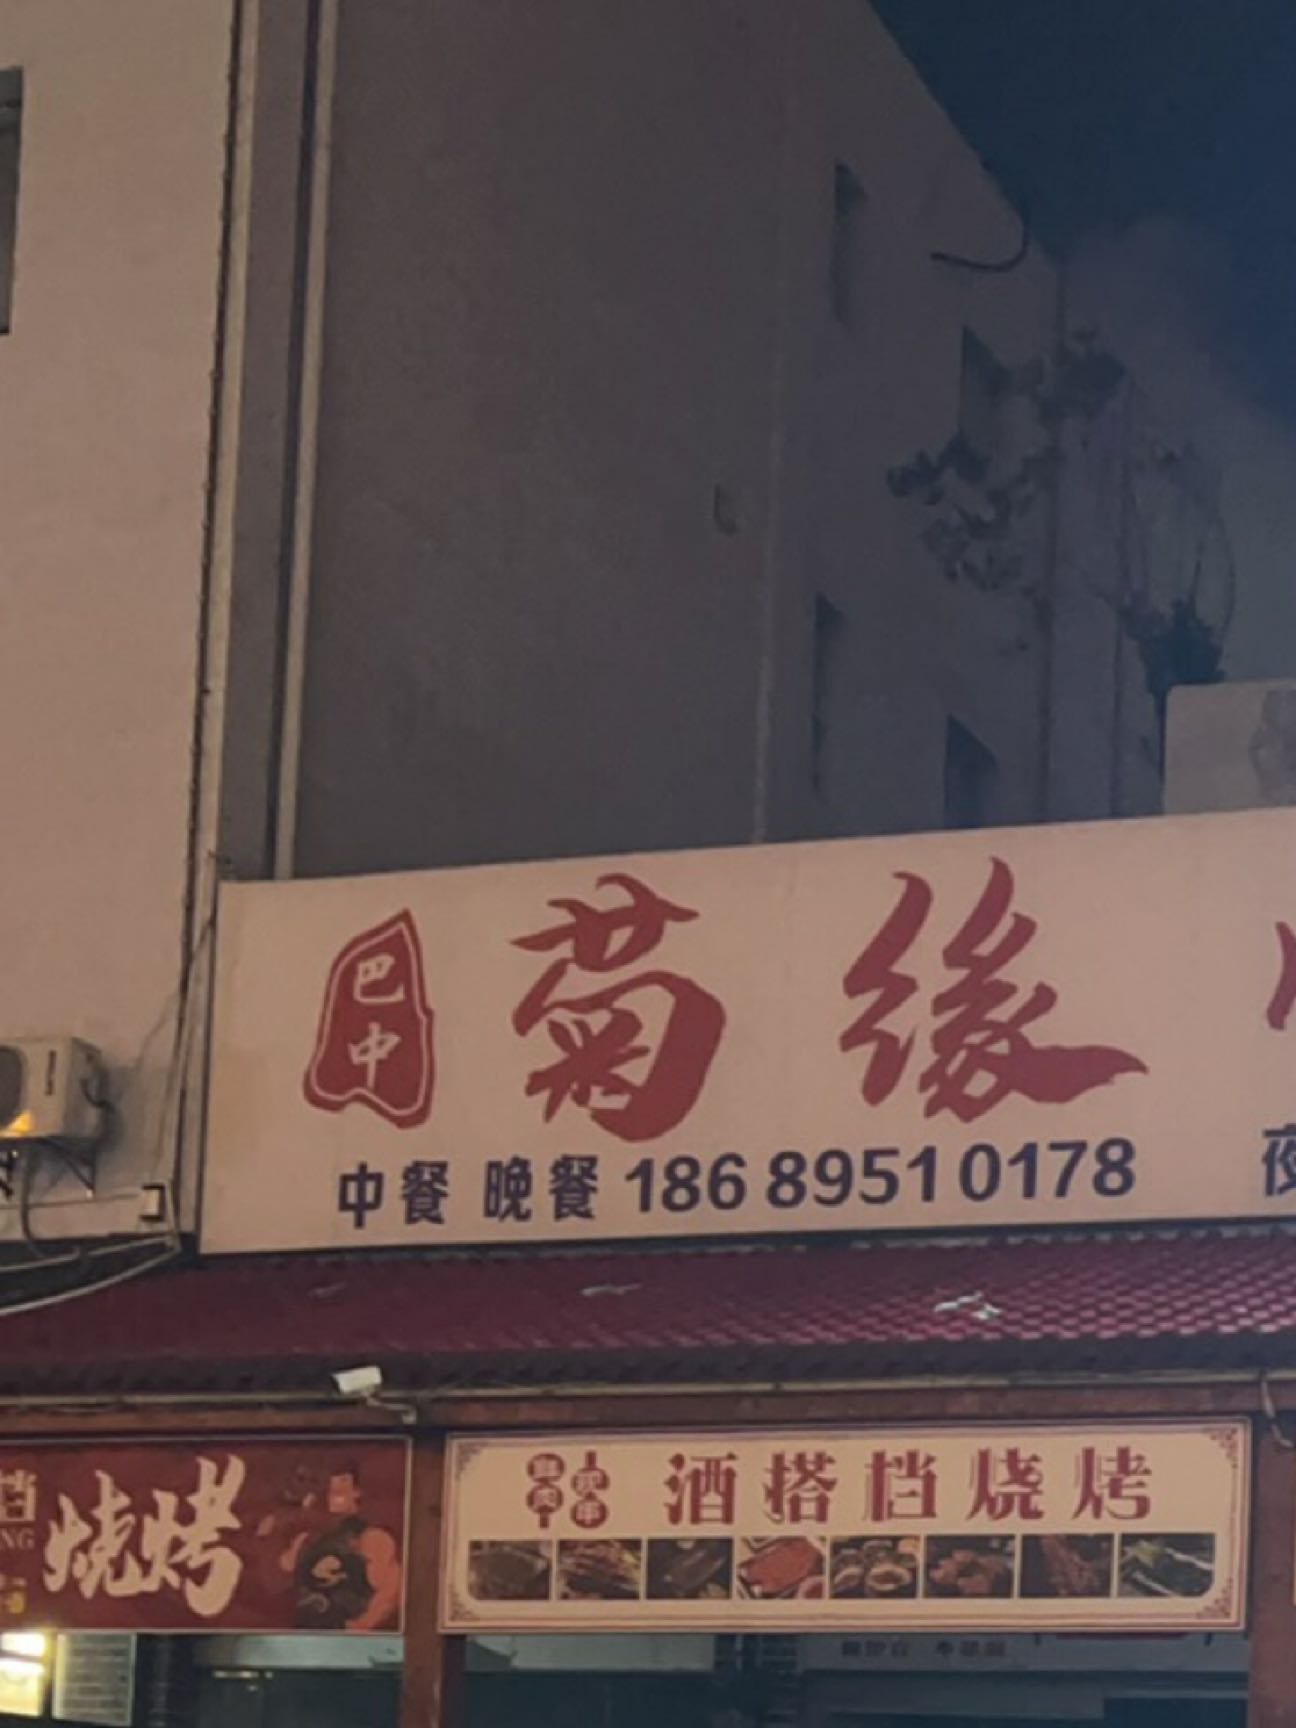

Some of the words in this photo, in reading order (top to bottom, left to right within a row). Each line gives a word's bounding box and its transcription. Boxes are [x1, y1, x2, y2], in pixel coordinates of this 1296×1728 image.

[348, 953, 402, 1093] 巴中
[338, 1160, 451, 1229] 中餐
[483, 1154, 600, 1223] 晚餐
[624, 1152, 747, 1213] 186
[768, 1146, 938, 1207] 8951
[960, 1137, 1136, 1200] 0178
[43, 1455, 246, 1616] 烧烤
[664, 1446, 1153, 1526] 酒搭档烧烤
